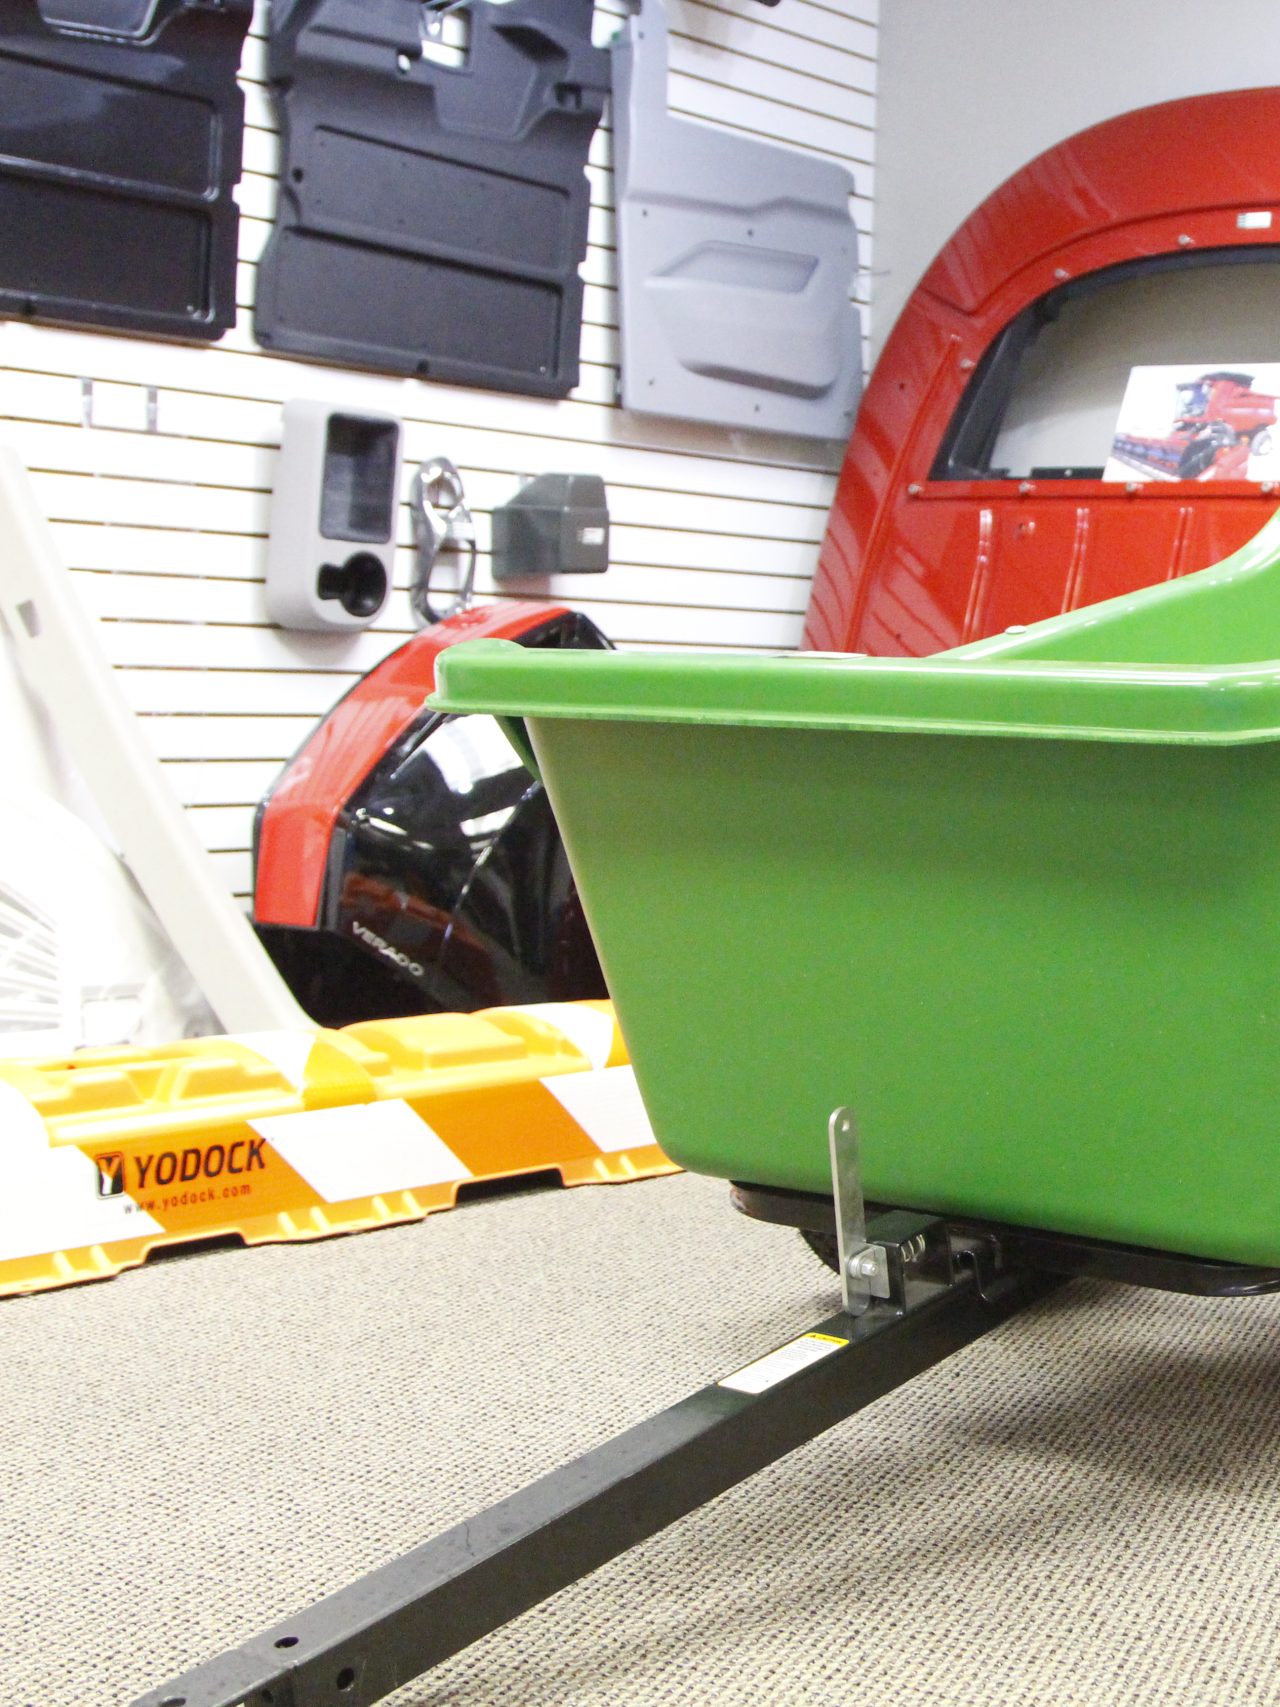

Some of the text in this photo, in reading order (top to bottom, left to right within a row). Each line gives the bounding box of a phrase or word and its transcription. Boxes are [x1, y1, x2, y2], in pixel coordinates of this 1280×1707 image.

[352, 921, 424, 976] VERADO
[134, 1137, 266, 1189] YODOCK
[123, 1183, 253, 1214] www.yodock.com
